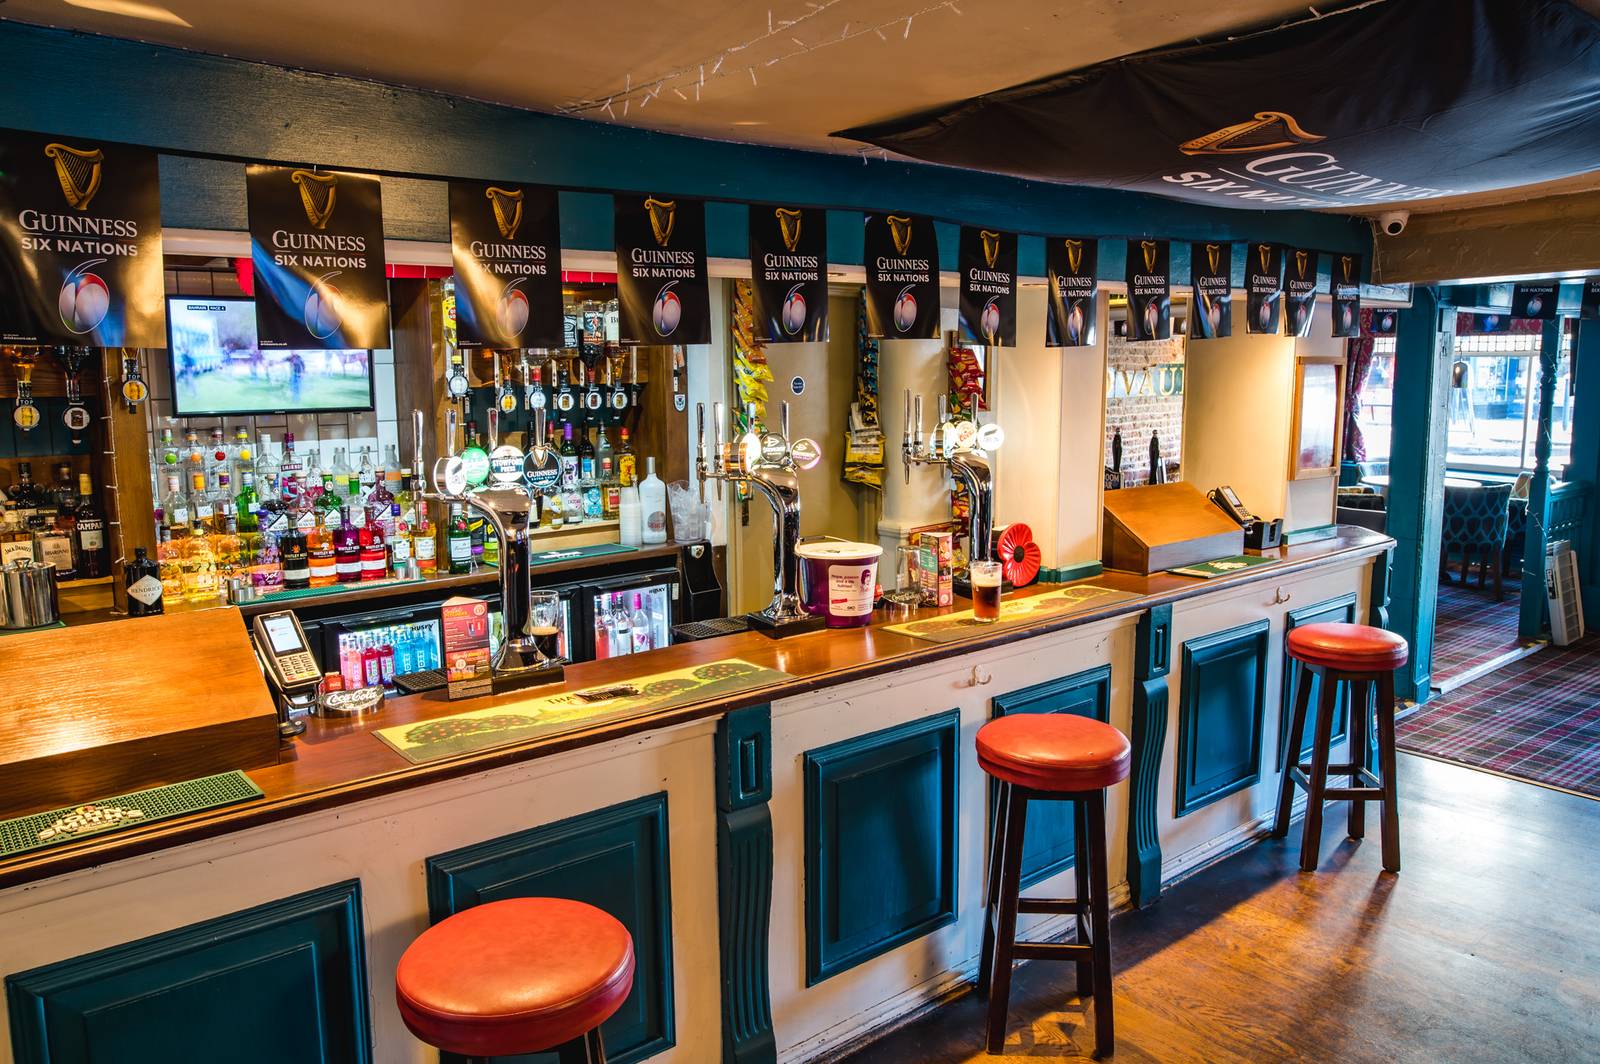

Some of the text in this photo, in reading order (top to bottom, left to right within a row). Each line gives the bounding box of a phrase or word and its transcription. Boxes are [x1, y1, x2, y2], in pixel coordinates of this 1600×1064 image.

[1161, 171, 1248, 193] SIX
[19, 210, 138, 238] GUINNESS
[21, 238, 138, 256] SIX NATIONS
[272, 230, 366, 252] GUINNESS
[470, 240, 546, 260] GUINNESS
[274, 254, 367, 269] SIX NATIONS
[631, 248, 695, 265] GUINNESS
[764, 253, 818, 268] GUINNESS
[494, 263, 547, 275] NATIONS
[876, 256, 929, 271] GUINNESS
[632, 267, 696, 279] SIX NATIONS
[765, 271, 818, 281] SIX NATIONS
[878, 273, 930, 283] SIX NATIONS
[969, 268, 1010, 284] GUINNESS
[1058, 275, 1092, 287] GUINNESS
[1134, 274, 1165, 285] GUINNESS
[1199, 276, 1227, 287] GUINNESS
[1252, 274, 1278, 285] GUINNESS
[1289, 280, 1313, 290] GUINNESS
[970, 283, 1010, 295] SIX NATIONS
[1058, 289, 1092, 297] SIX NATIONS
[1144, 287, 1165, 295] NATIONS
[527, 470, 558, 478] GUINNESS
[411, 624, 434, 632] HUSKY
